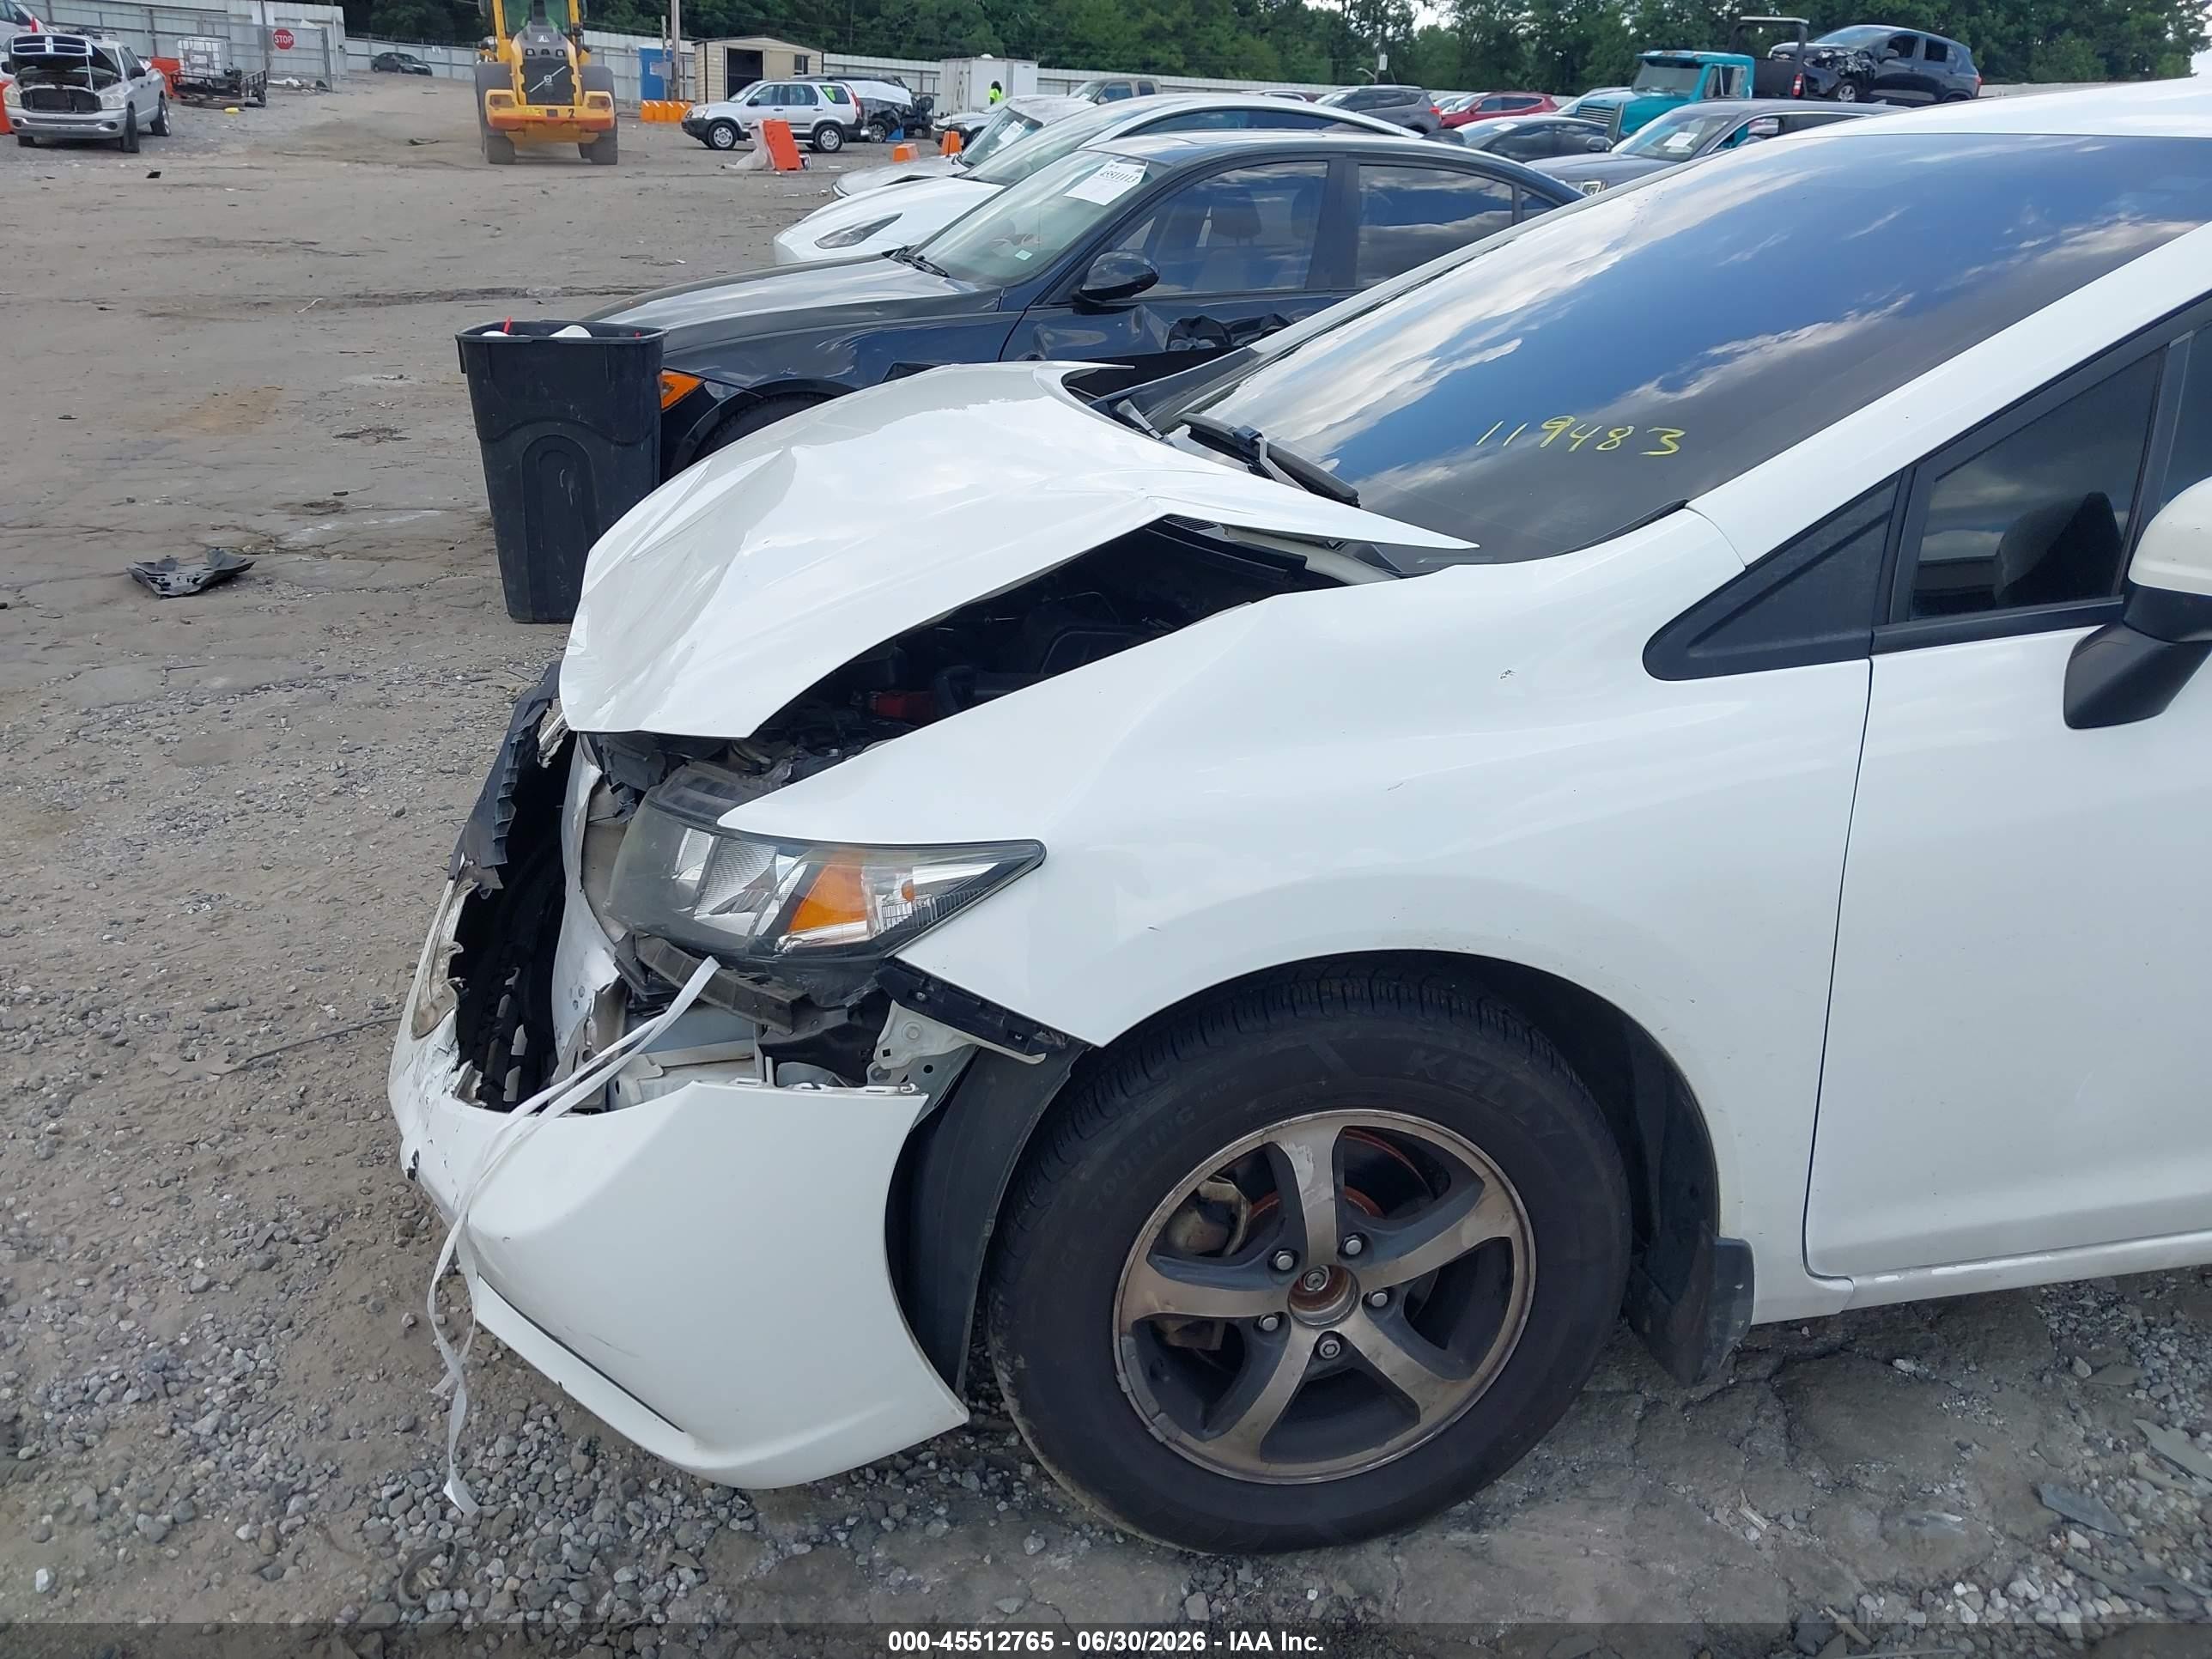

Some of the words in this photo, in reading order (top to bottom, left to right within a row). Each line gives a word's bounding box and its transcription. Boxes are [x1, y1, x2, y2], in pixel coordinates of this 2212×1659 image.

[275, 34, 293, 44] STOP
[568, 108, 575, 118] 2
[1475, 416, 1686, 456] 119483
[1403, 1046, 1570, 1140] KELLY
[1085, 1104, 1197, 1212] TOURING
